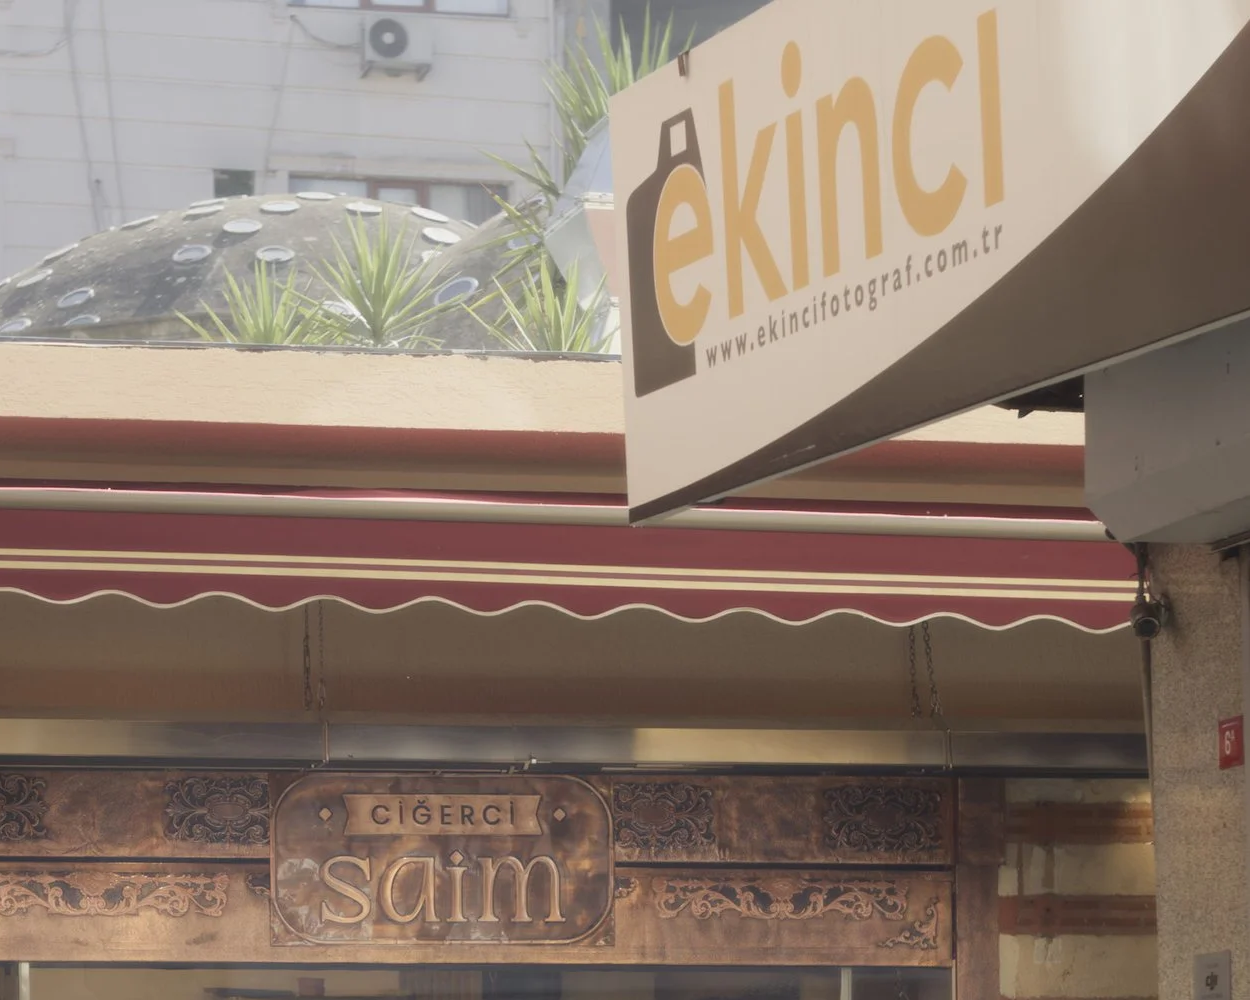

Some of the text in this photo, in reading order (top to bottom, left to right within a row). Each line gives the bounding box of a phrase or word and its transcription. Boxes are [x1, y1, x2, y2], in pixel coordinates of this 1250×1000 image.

[706, 224, 1003, 368] www.ekincifotograf.com.tr
[370, 799, 516, 826] CİĞERCİ
[318, 850, 567, 923] saim
